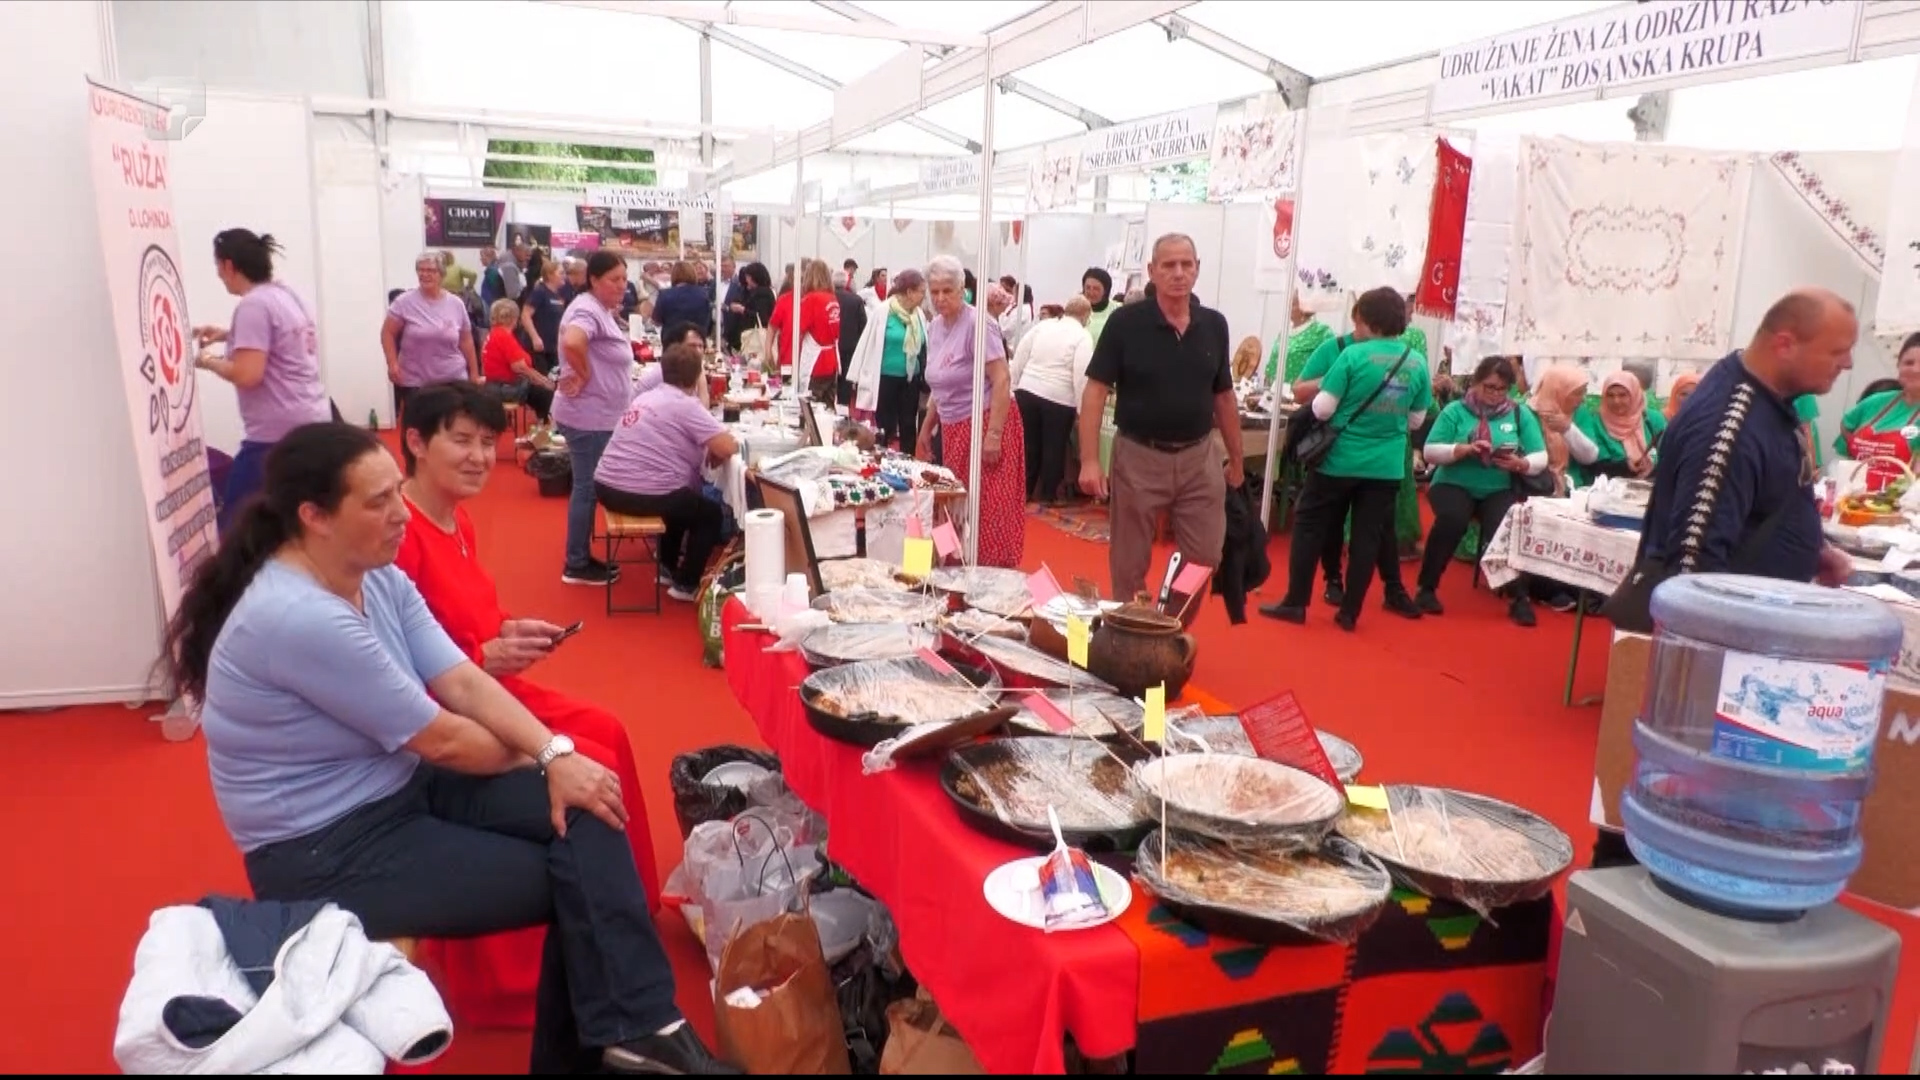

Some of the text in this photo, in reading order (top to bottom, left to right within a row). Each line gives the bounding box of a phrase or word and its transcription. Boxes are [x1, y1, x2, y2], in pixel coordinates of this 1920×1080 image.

[1441, 36, 1540, 79] UDRUŽENJE
[1544, 27, 1595, 60] ŽENA
[1601, 19, 1628, 49] ZA
[1481, 30, 1763, 100] "VAKAT" BOSANSKA KRUPA
[1150, 133, 1207, 159] SREBRENIK
[448, 207, 490, 219] CHOCO
